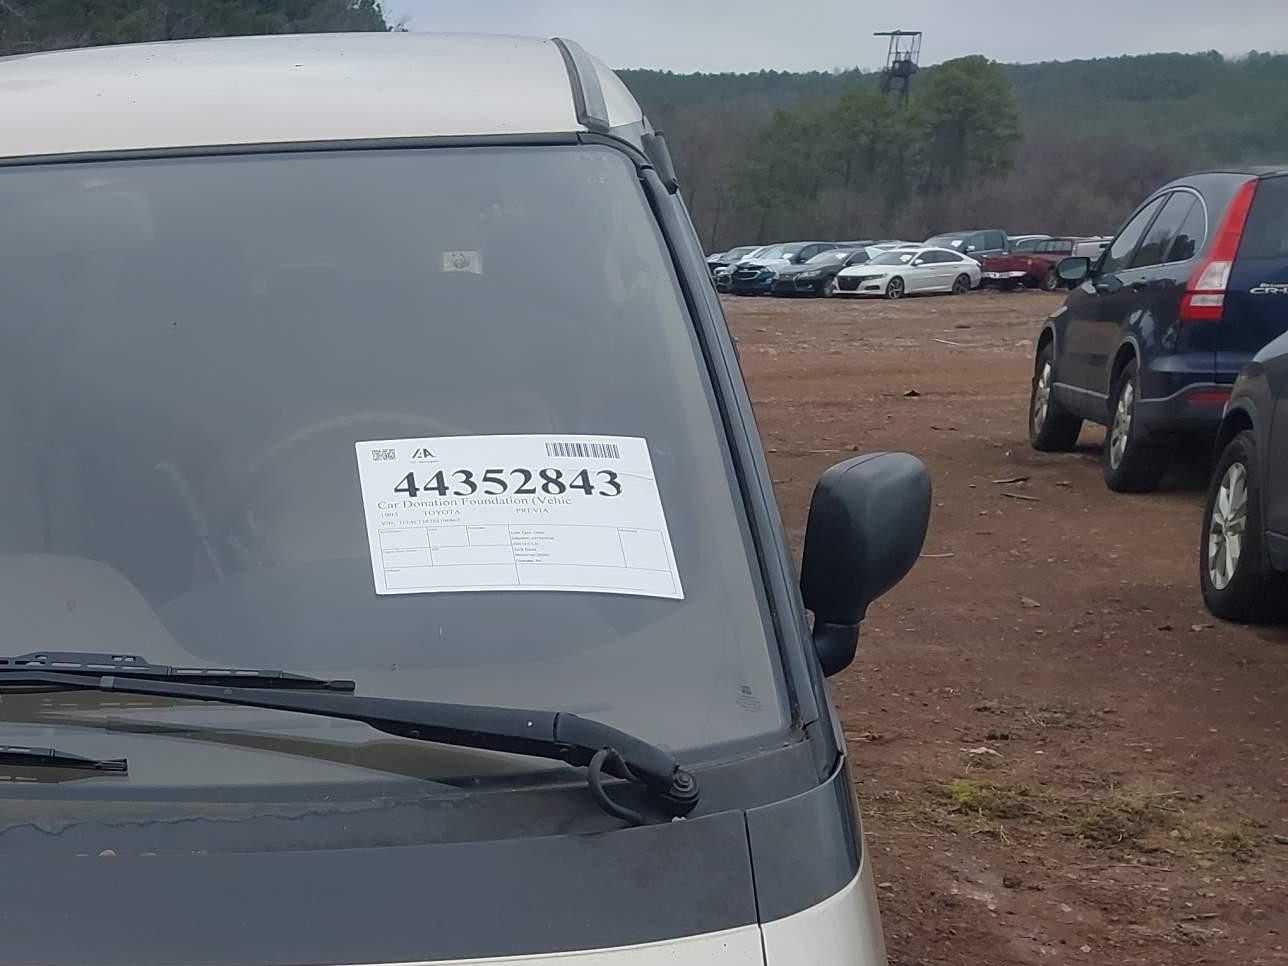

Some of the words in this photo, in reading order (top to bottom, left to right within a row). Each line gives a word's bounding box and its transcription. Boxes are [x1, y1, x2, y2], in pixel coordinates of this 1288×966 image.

[394, 468, 622, 497] 44352843
[378, 501, 400, 511] Car
[403, 498, 458, 509] Donation
[462, 496, 528, 506] Foundation
